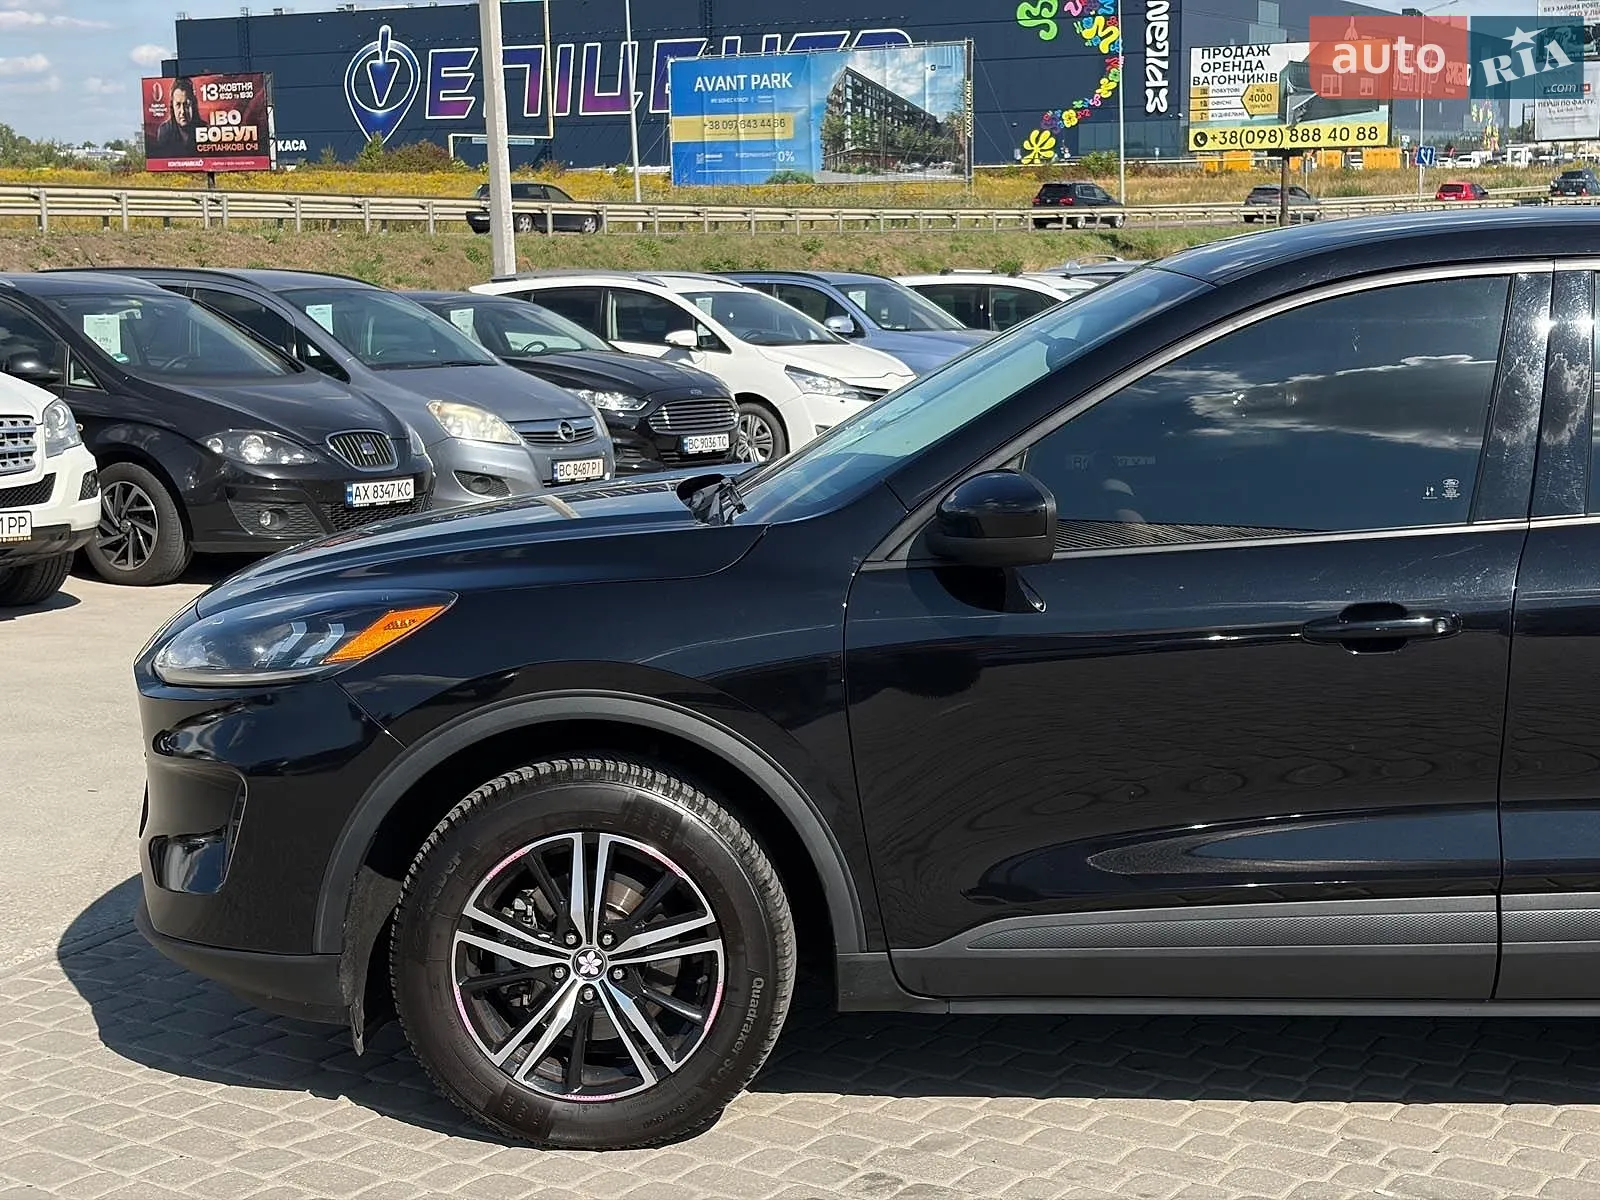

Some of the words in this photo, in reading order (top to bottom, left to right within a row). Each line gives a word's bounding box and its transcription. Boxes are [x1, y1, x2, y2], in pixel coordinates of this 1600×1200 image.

[1201, 45, 1271, 60] ПРОДАЖ
[1200, 60, 1265, 73] ОРЕНДА
[694, 75, 748, 92] AVANT
[751, 72, 793, 89] PARK
[1192, 73, 1278, 86] ВАГОНЧИКІВ
[200, 83, 219, 101] 13
[219, 82, 253, 92] ЖОВТНЯ
[1248, 93, 1273, 103] 4000
[209, 109, 242, 125] ІВО
[195, 126, 258, 143] БОБУЛ
[1210, 128, 1284, 148] +38(098)
[1289, 127, 1321, 143] 888
[1328, 126, 1350, 141] 40
[1357, 126, 1378, 141] 88
[197, 143, 244, 152] СЕРПАНКОВІ
[245, 142, 258, 150] ОЧІ
[277, 139, 307, 151] КАСА
[777, 151, 795, 162] 0%
[559, 463, 572, 476] BC
[354, 485, 370, 501] AX
[372, 483, 395, 499] 8347
[397, 481, 411, 497] KC
[8, 516, 27, 534] PP
[730, 976, 766, 1060] Quadraxer
